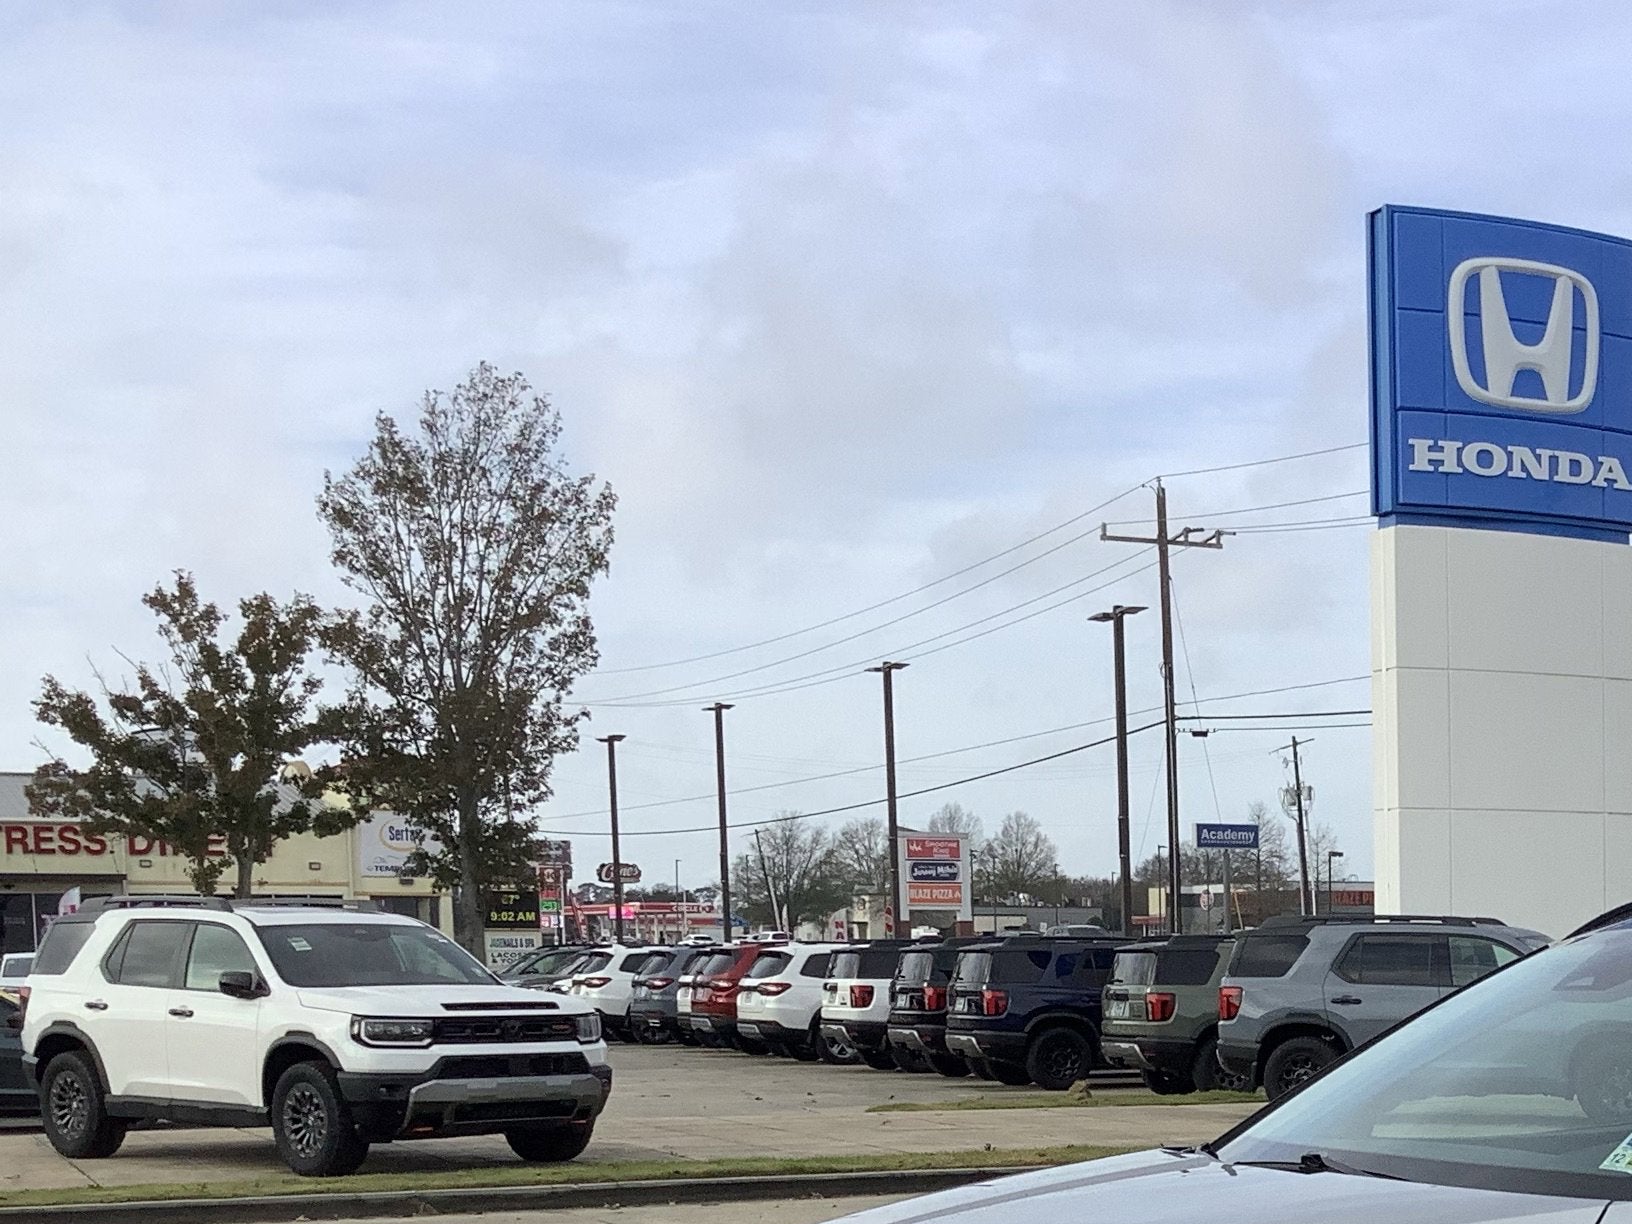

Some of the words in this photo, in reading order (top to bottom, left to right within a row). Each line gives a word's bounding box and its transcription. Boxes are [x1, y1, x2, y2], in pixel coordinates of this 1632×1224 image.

[0, 825, 108, 856] RESS
[1201, 828, 1255, 843] Academy
[932, 888, 953, 899] PIZZA
[490, 911, 515, 922] 9:02
[517, 911, 536, 922] AM
[1610, 1152, 1627, 1164] 12
